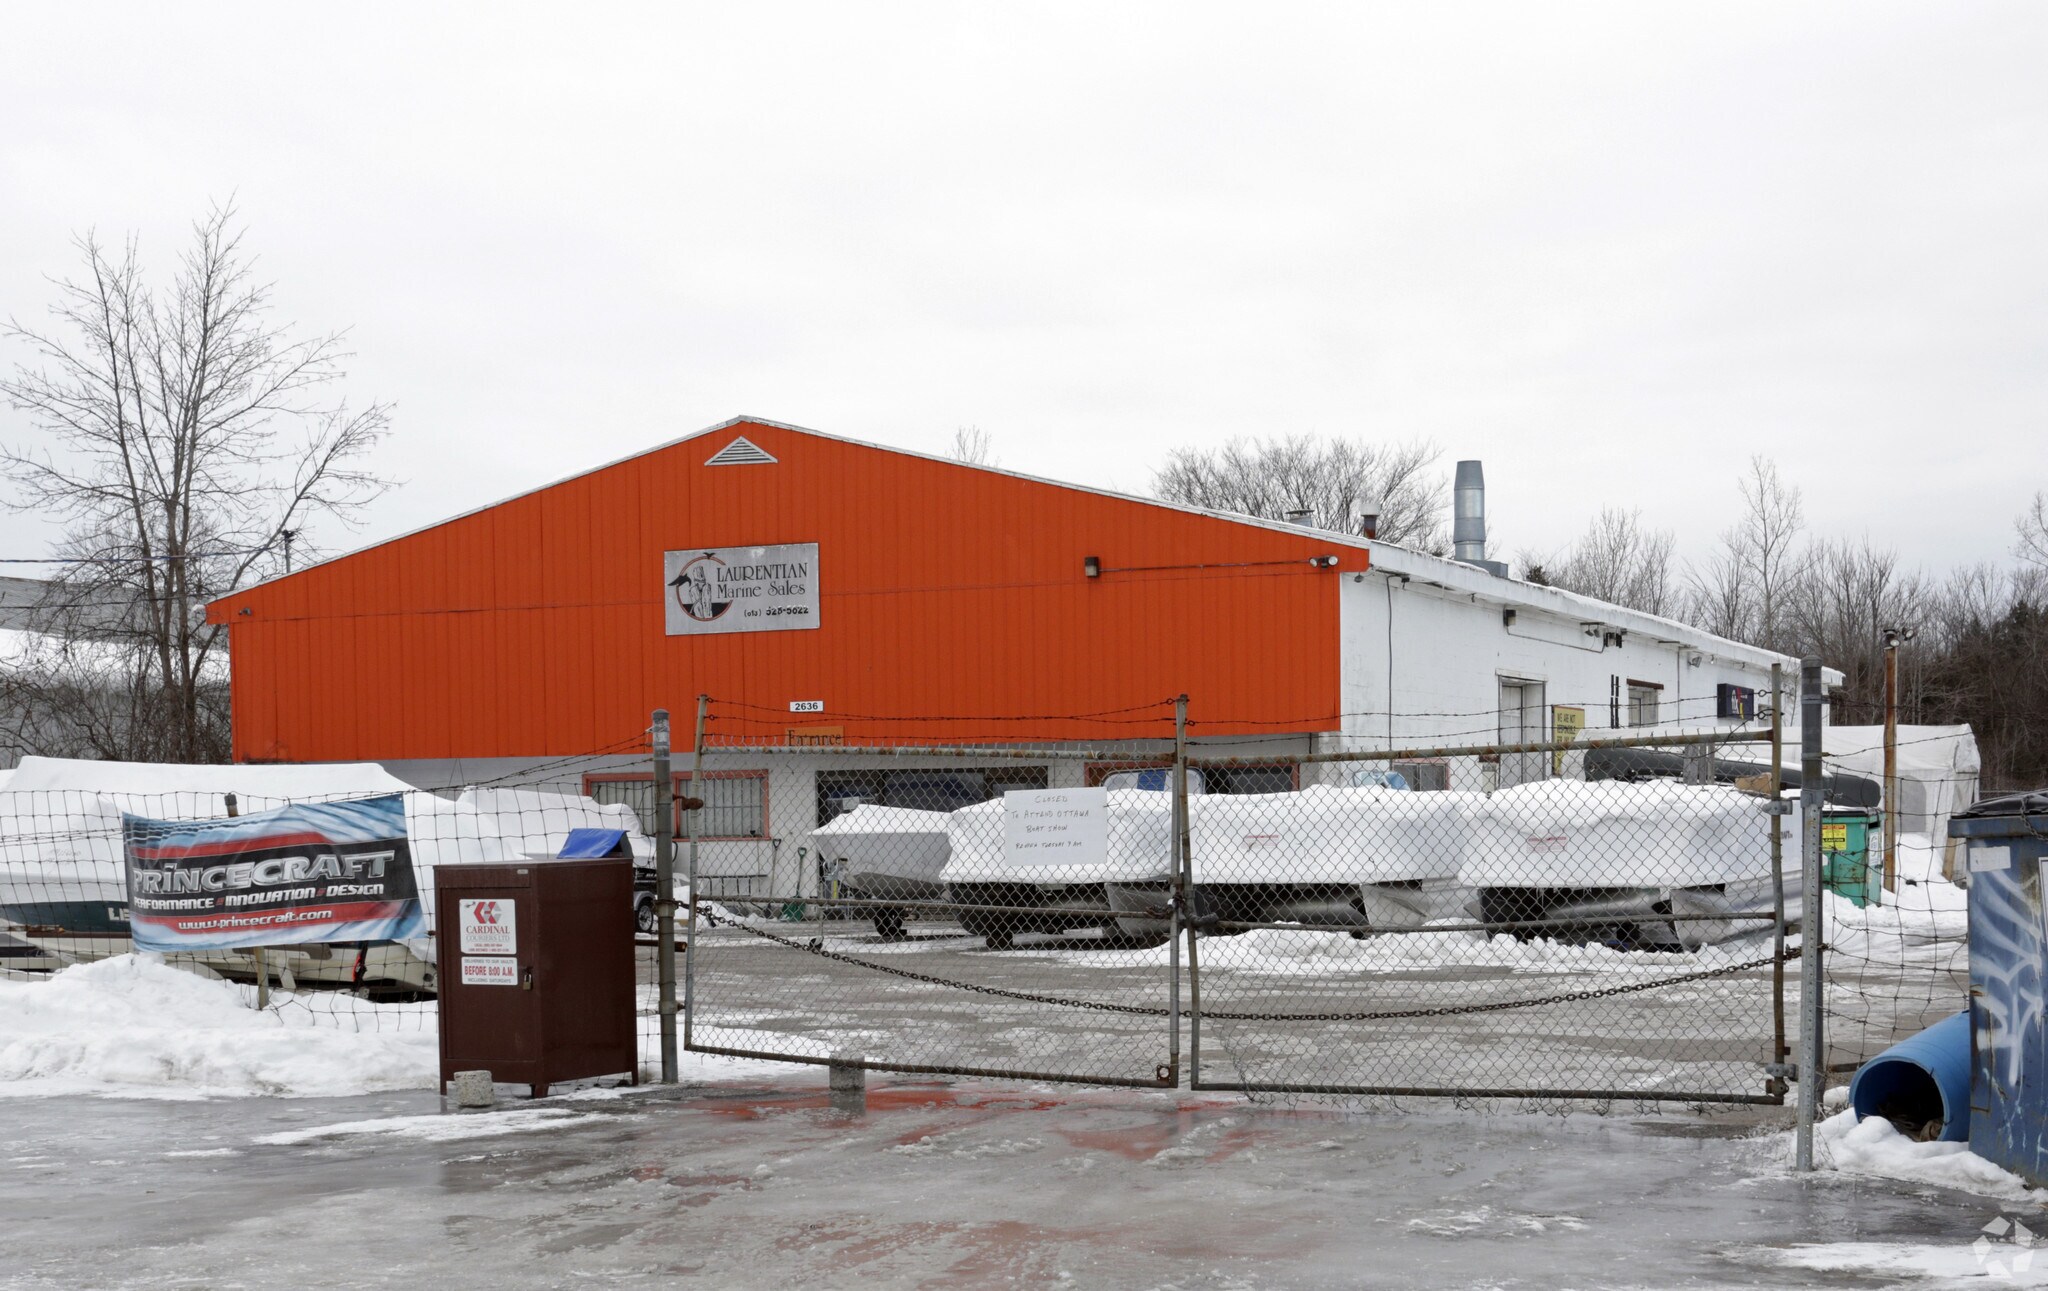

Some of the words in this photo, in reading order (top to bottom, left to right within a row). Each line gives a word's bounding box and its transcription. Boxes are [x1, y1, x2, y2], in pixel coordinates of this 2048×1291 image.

[717, 563, 808, 582] LAURENTIAN
[717, 583, 762, 599] Marine
[768, 580, 806, 597] Sales
[795, 702, 819, 711] 2636
[1034, 795, 1068, 803] CLOSED
[1057, 810, 1089, 818] OTTAWA
[134, 896, 215, 910] PERFORMANCE
[225, 887, 316, 907] INNOVATION
[326, 883, 385, 897] DESIGN
[178, 910, 332, 930] www.princecraft.com
[466, 925, 511, 934] CARDINAL
[464, 965, 487, 976] BEFORE
